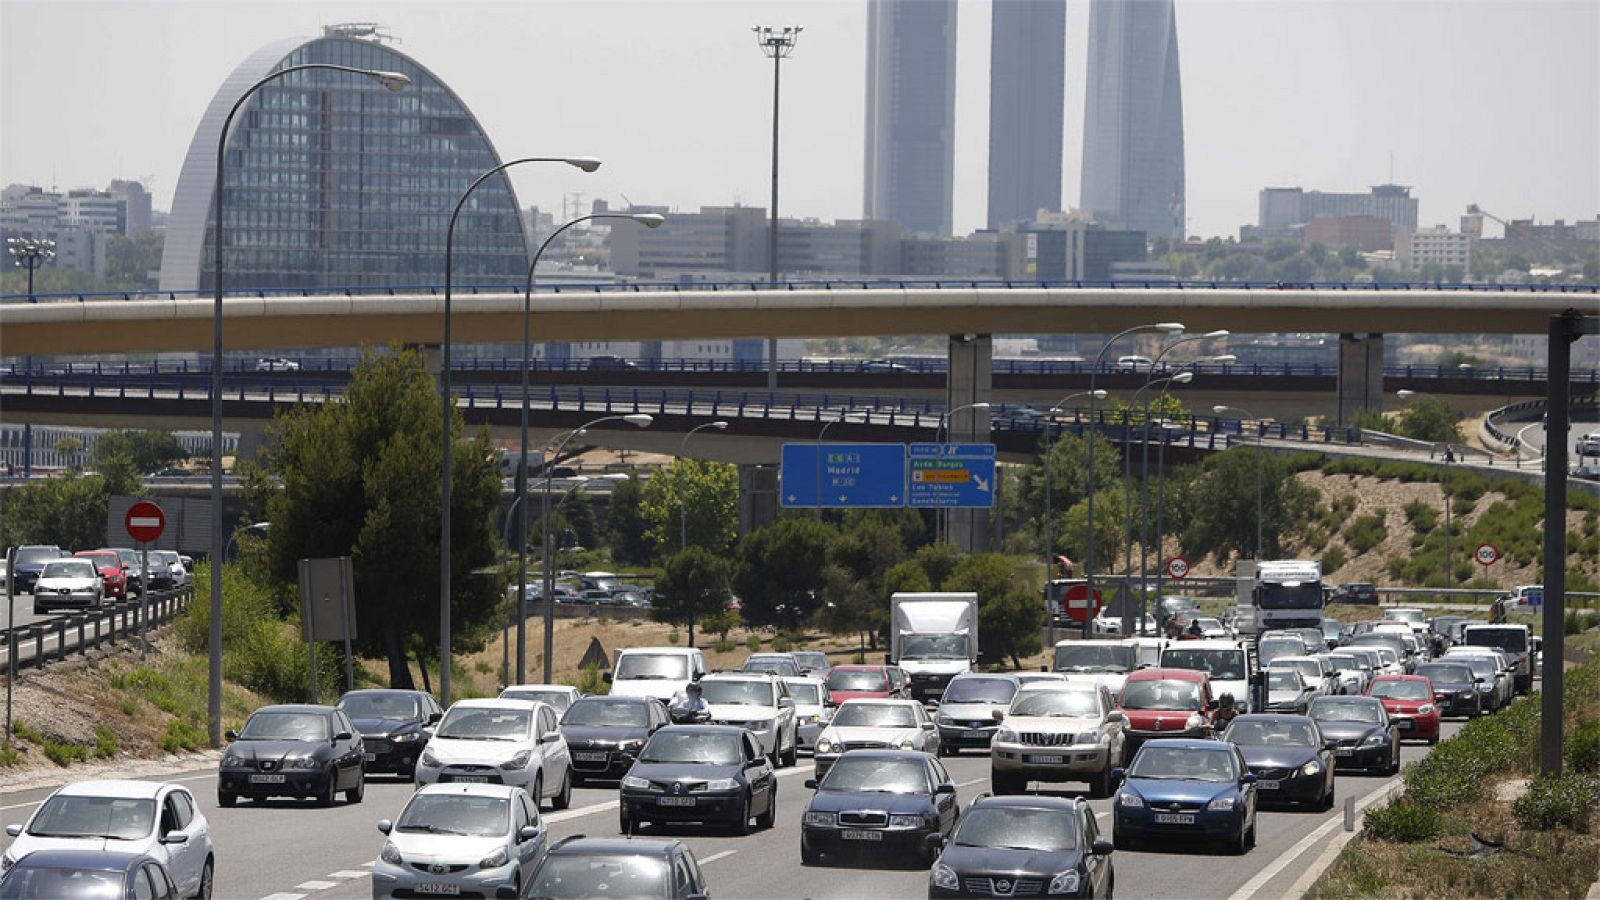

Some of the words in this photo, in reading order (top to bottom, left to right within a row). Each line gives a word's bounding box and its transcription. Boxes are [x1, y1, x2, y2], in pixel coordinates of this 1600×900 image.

[827, 466, 860, 475] Madrid
[1479, 550, 1494, 559] 100
[1171, 563, 1186, 573] 100
